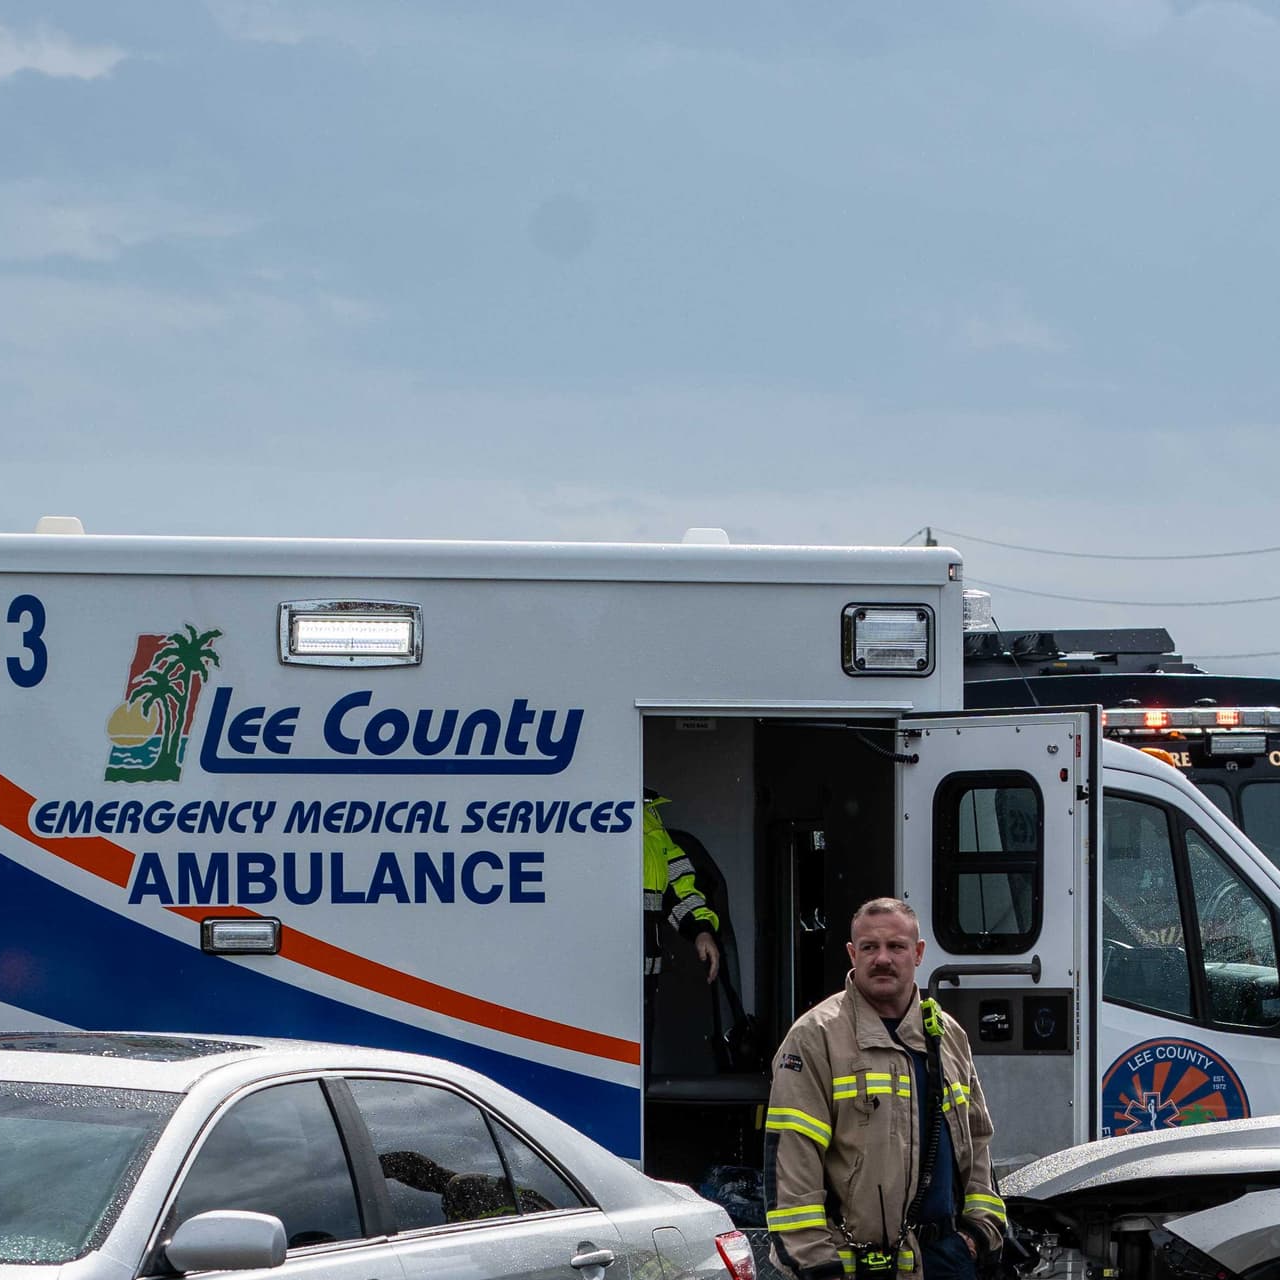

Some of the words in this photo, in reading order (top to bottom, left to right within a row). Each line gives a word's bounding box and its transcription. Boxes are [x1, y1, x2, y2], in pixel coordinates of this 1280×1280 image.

[199, 686, 300, 774] Lee
[320, 690, 584, 774] County
[1171, 752, 1192, 767] RE
[34, 801, 275, 834] EMERGENCY
[283, 801, 453, 834] MEDICAL
[460, 801, 635, 834] SERVICES
[127, 851, 545, 905] AMBULANCE
[1127, 1050, 1154, 1072] LEE
[1156, 1046, 1214, 1071] COUNTY
